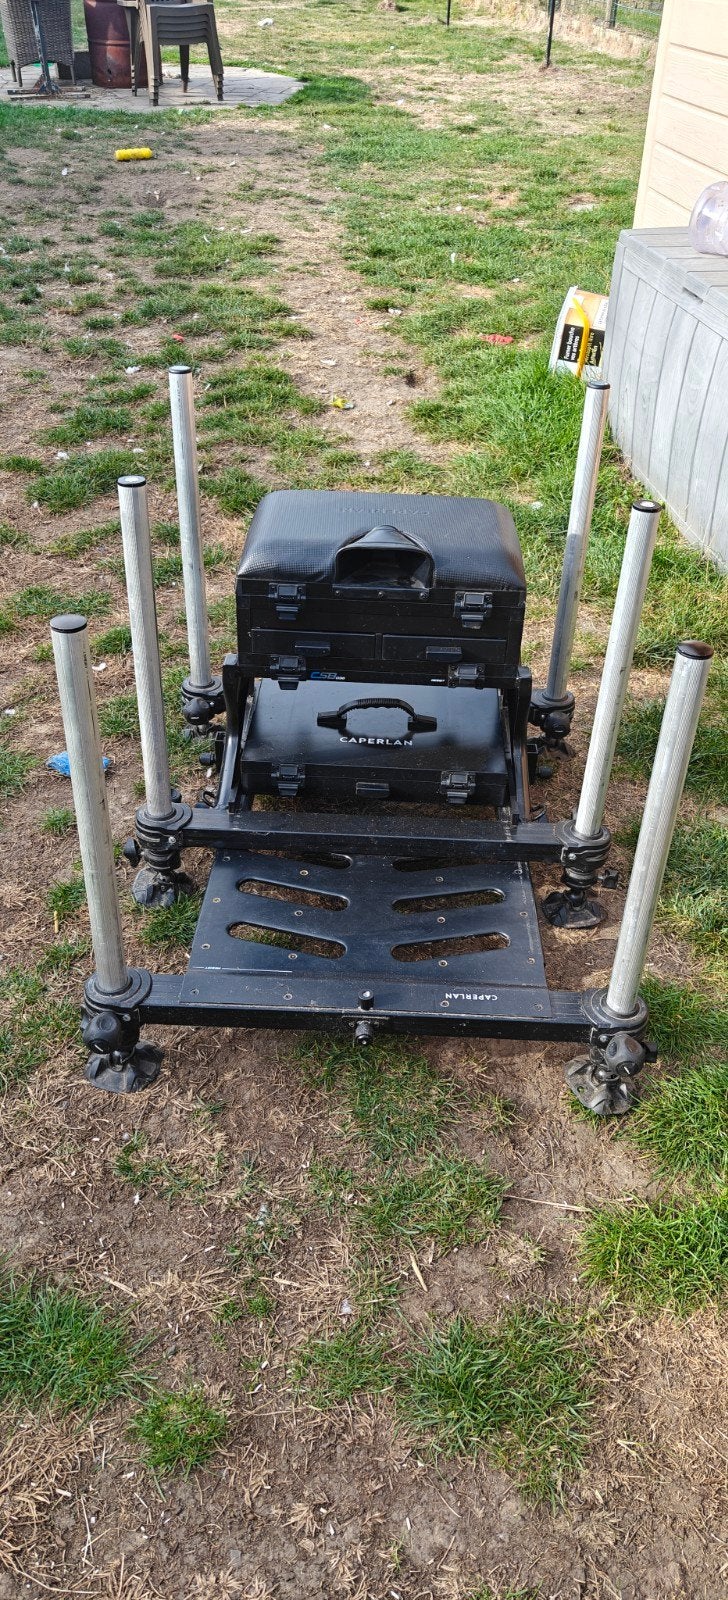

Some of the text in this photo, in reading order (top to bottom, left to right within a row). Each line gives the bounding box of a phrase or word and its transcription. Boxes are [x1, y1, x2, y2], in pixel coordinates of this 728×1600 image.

[564, 327, 576, 360] Fumer bouche
[340, 736, 413, 746] CAPERLAN
[445, 993, 498, 1001] CAPERLAN
